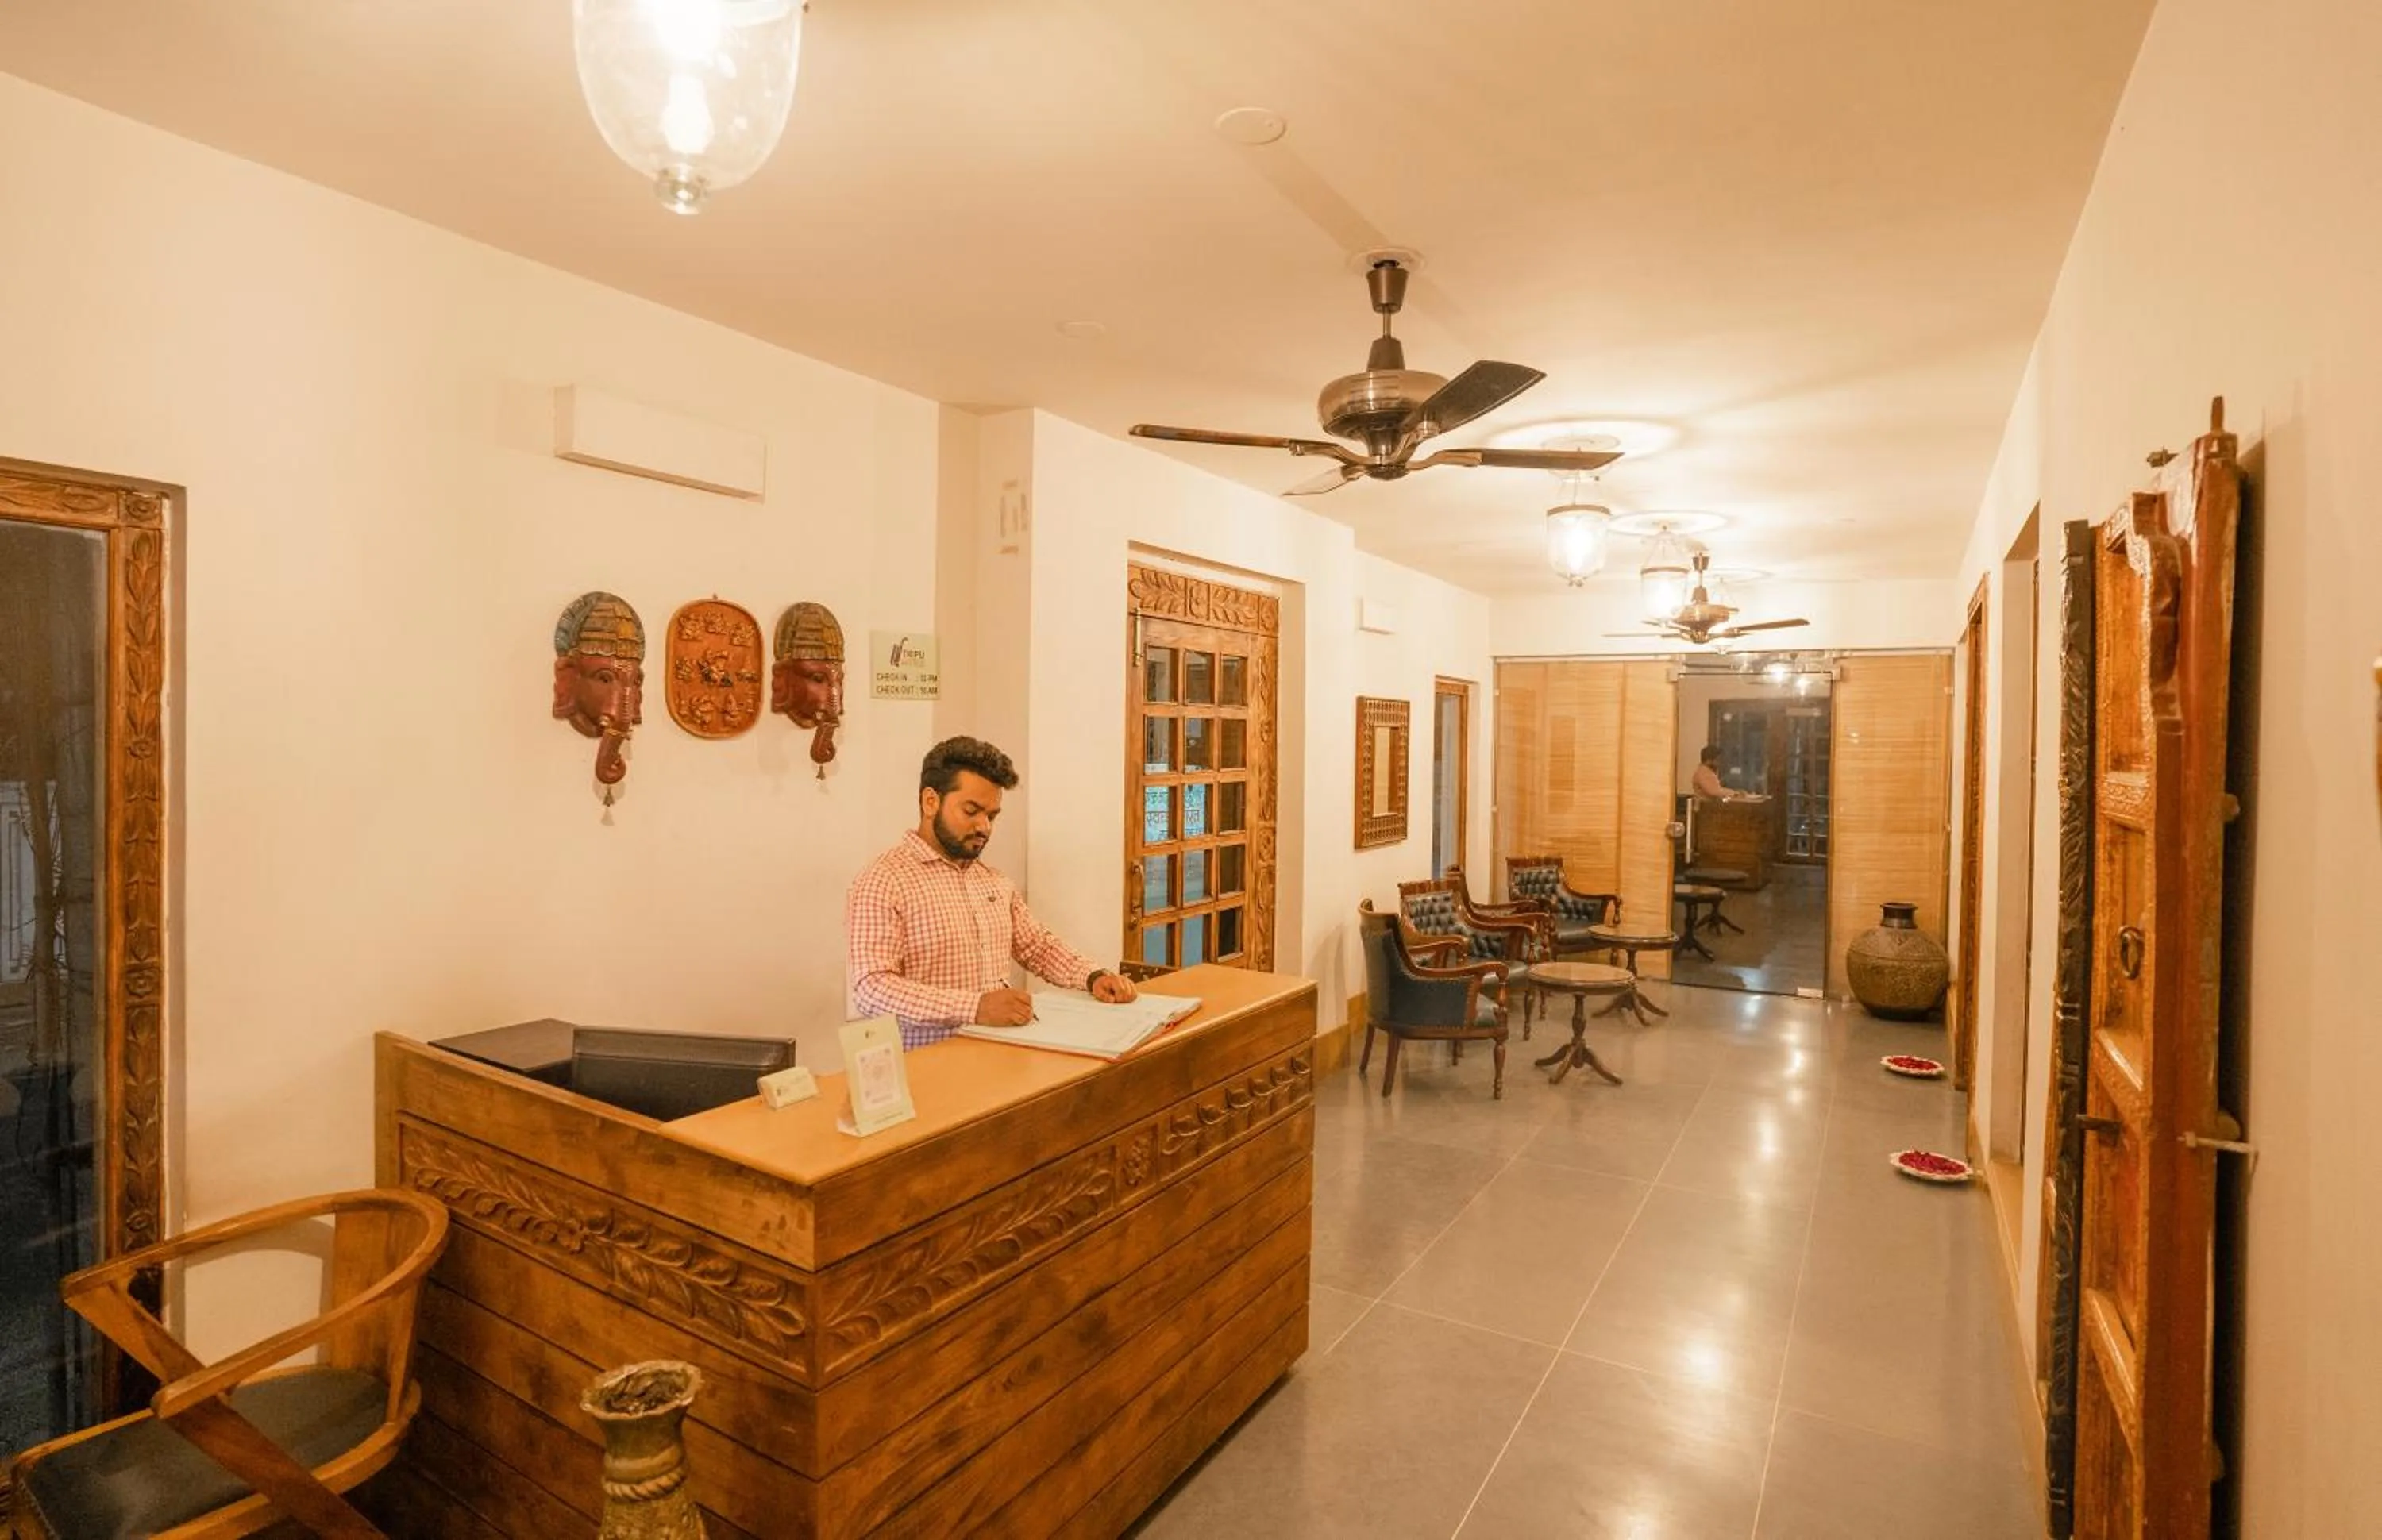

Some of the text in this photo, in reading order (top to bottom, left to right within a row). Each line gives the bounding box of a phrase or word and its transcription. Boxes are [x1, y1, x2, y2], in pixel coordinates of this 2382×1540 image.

[876, 672, 899, 681] CHECK
[876, 685, 899, 694] CHECK
[900, 685, 914, 695] OUT
